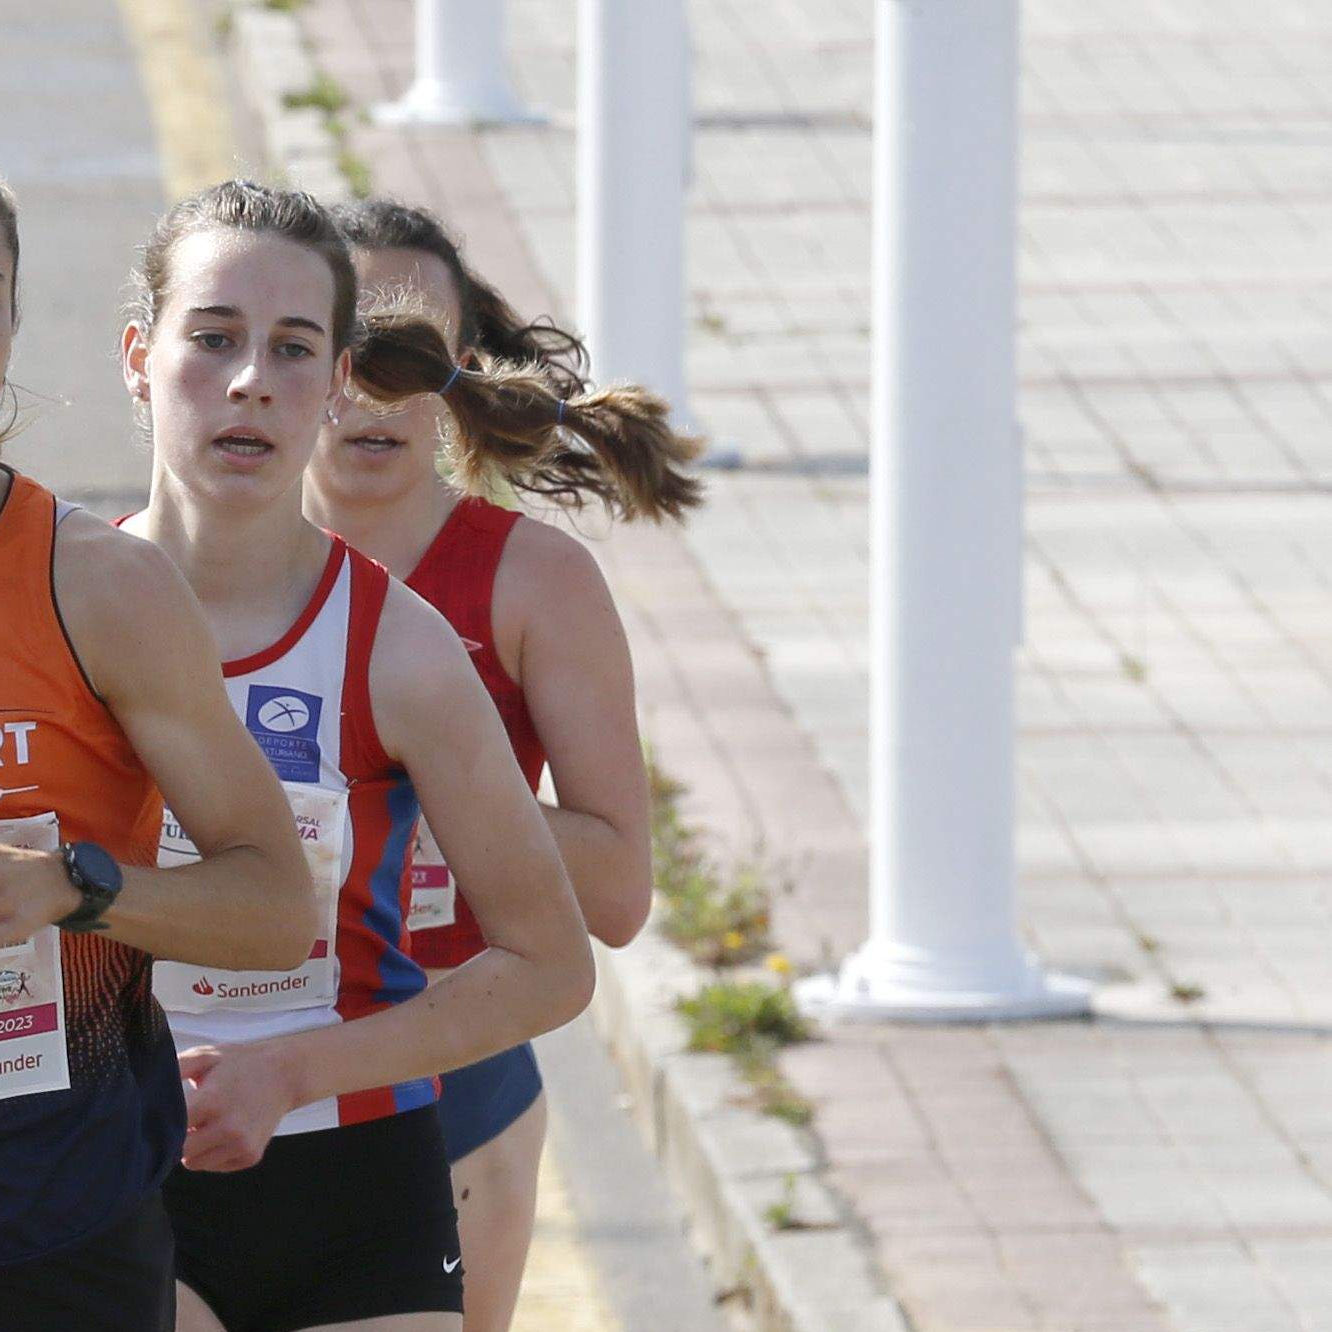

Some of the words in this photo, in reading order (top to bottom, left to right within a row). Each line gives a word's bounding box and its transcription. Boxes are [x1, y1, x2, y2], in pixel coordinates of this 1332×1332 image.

[258, 736, 307, 749] DEPORTE
[264, 746, 308, 760] STURIANO
[217, 976, 309, 998] Santander
